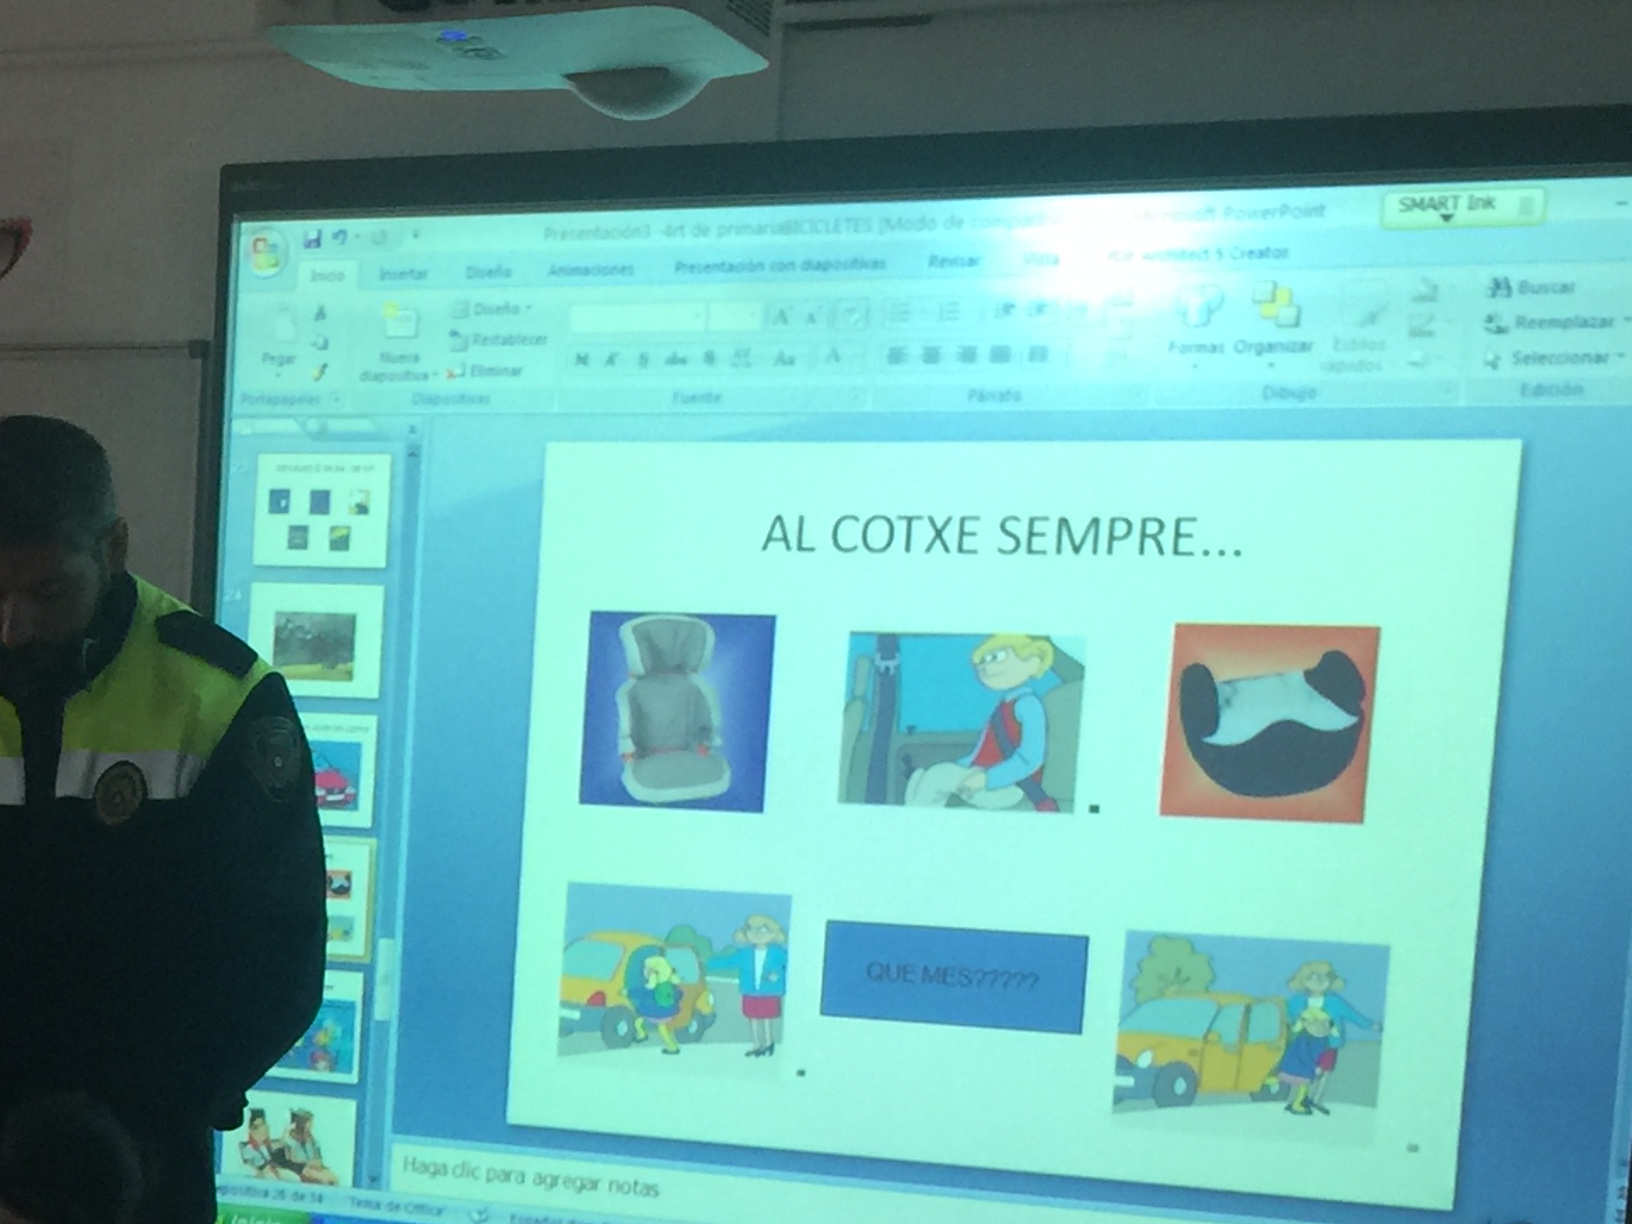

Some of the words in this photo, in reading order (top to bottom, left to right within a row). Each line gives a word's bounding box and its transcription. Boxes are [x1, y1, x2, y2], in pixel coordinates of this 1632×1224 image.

[1222, 203, 1326, 221] PowerPoint
[1398, 194, 1462, 213] SMART
[1467, 193, 1497, 212] Ink
[689, 221, 710, 238] de
[940, 214, 962, 231] de
[546, 262, 635, 278] Animaciones
[674, 257, 765, 275] Presentación
[769, 261, 796, 273] con
[800, 256, 887, 273] diapositivas
[926, 253, 981, 269] Revisar
[310, 268, 346, 284] Inicio
[379, 264, 429, 282] Insertar
[465, 264, 513, 280] Diseño
[1517, 278, 1577, 297] Buscar
[1514, 313, 1616, 331] Reemplazar
[472, 332, 550, 347] Restablecer
[1168, 339, 1226, 356] Formas
[1233, 338, 1315, 359] Organizar
[1512, 348, 1610, 366] Seleccionar
[470, 363, 523, 379] Eliminar
[672, 389, 723, 404] Fuente
[1262, 383, 1318, 403] Dibujo
[1519, 380, 1585, 399] Edición
[761, 511, 817, 555] AL
[829, 513, 981, 556] COTXE
[995, 513, 1244, 560] SEMPRE...
[865, 960, 917, 986] QUE
[401, 1155, 449, 1181] Haga
[451, 1160, 481, 1181] clic
[485, 1166, 526, 1185] para
[532, 1171, 602, 1195] agregar
[607, 1176, 661, 1199] notas
[385, 1199, 402, 1213] de
